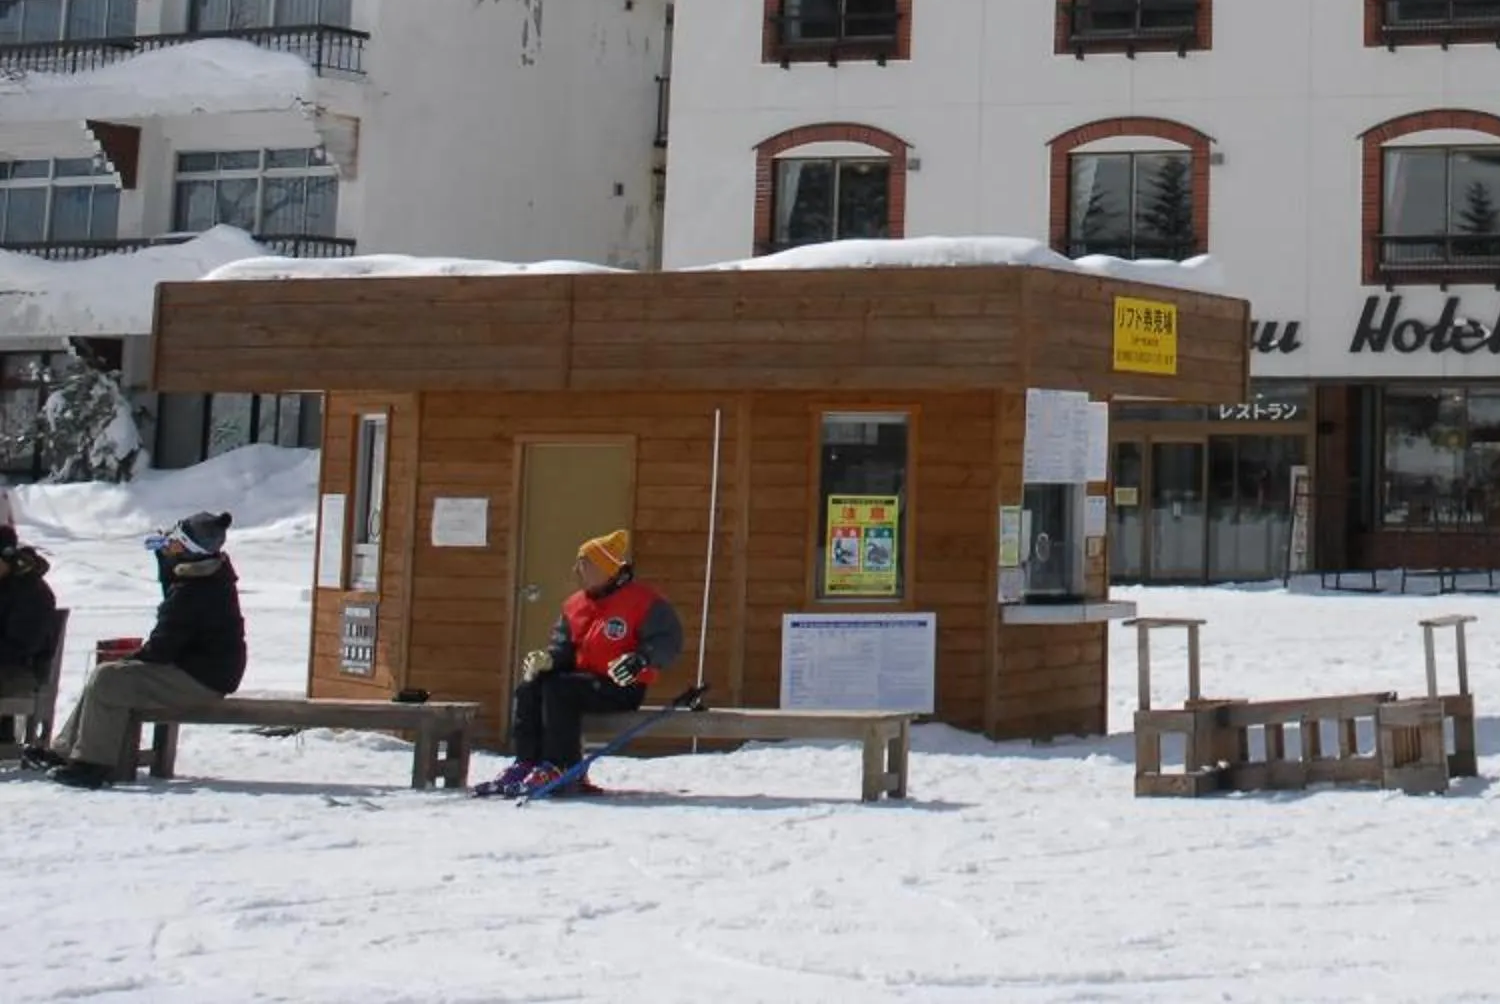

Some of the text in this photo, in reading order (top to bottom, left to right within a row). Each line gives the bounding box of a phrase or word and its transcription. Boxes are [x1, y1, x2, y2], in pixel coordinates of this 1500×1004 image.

[1218, 402, 1297, 421] レストラン
